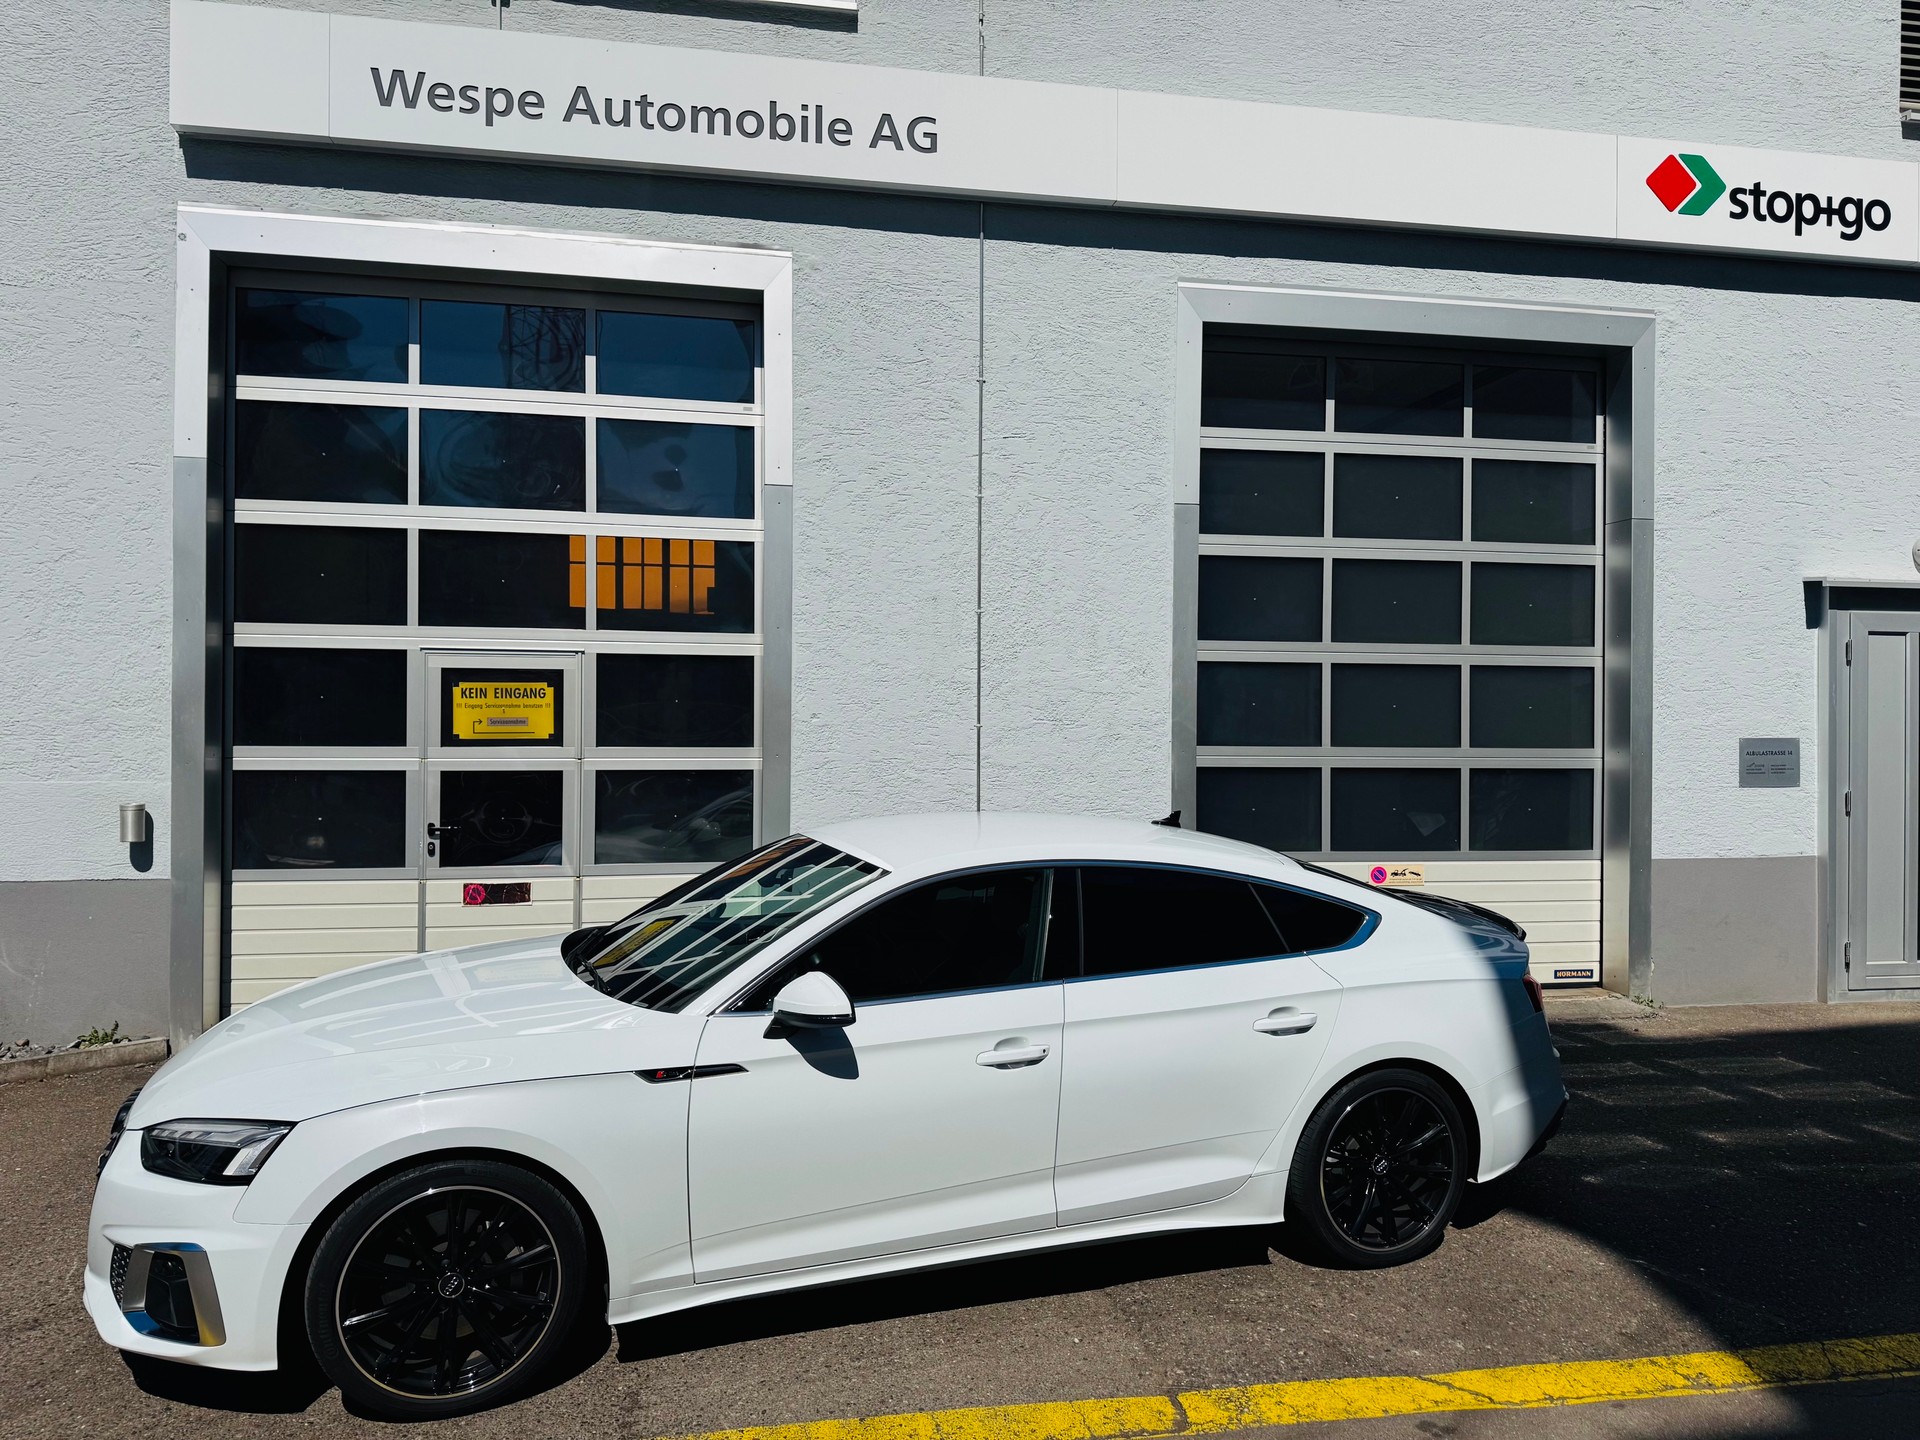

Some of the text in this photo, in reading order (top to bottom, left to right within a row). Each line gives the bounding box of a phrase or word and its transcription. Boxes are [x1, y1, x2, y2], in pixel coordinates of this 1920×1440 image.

[369, 67, 938, 154] Wespe Automobile AG
[1729, 181, 1891, 241] stop+go
[461, 687, 546, 699] KEIN EINGANG
